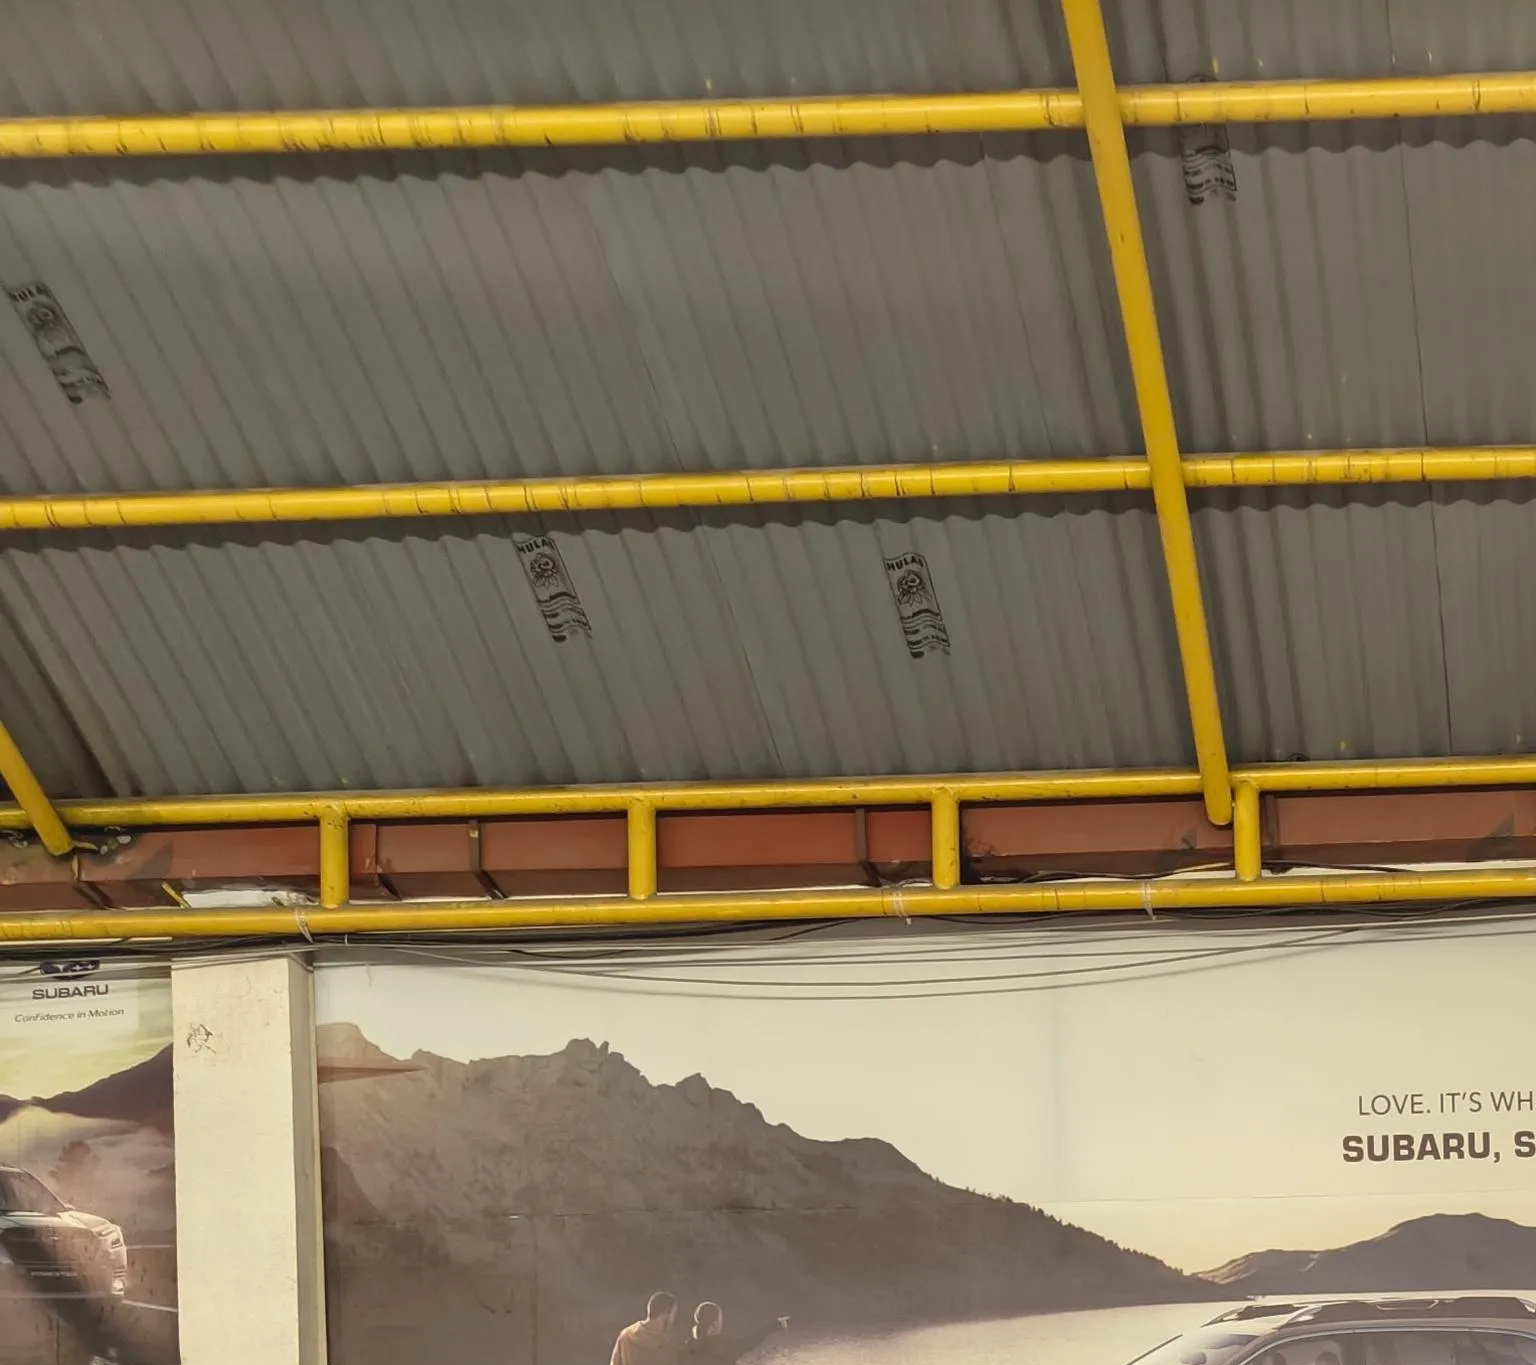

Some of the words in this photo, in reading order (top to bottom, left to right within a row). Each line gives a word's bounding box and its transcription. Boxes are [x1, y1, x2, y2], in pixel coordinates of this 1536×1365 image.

[31, 983, 110, 1000] SUBARU
[14, 1012, 74, 1023] Confidence
[77, 1010, 87, 1019] in
[88, 1008, 125, 1019] Motion
[1358, 1093, 1432, 1116] LOVE.
[1439, 1091, 1483, 1114] IT'S
[1342, 1131, 1501, 1164] SUBARU,
